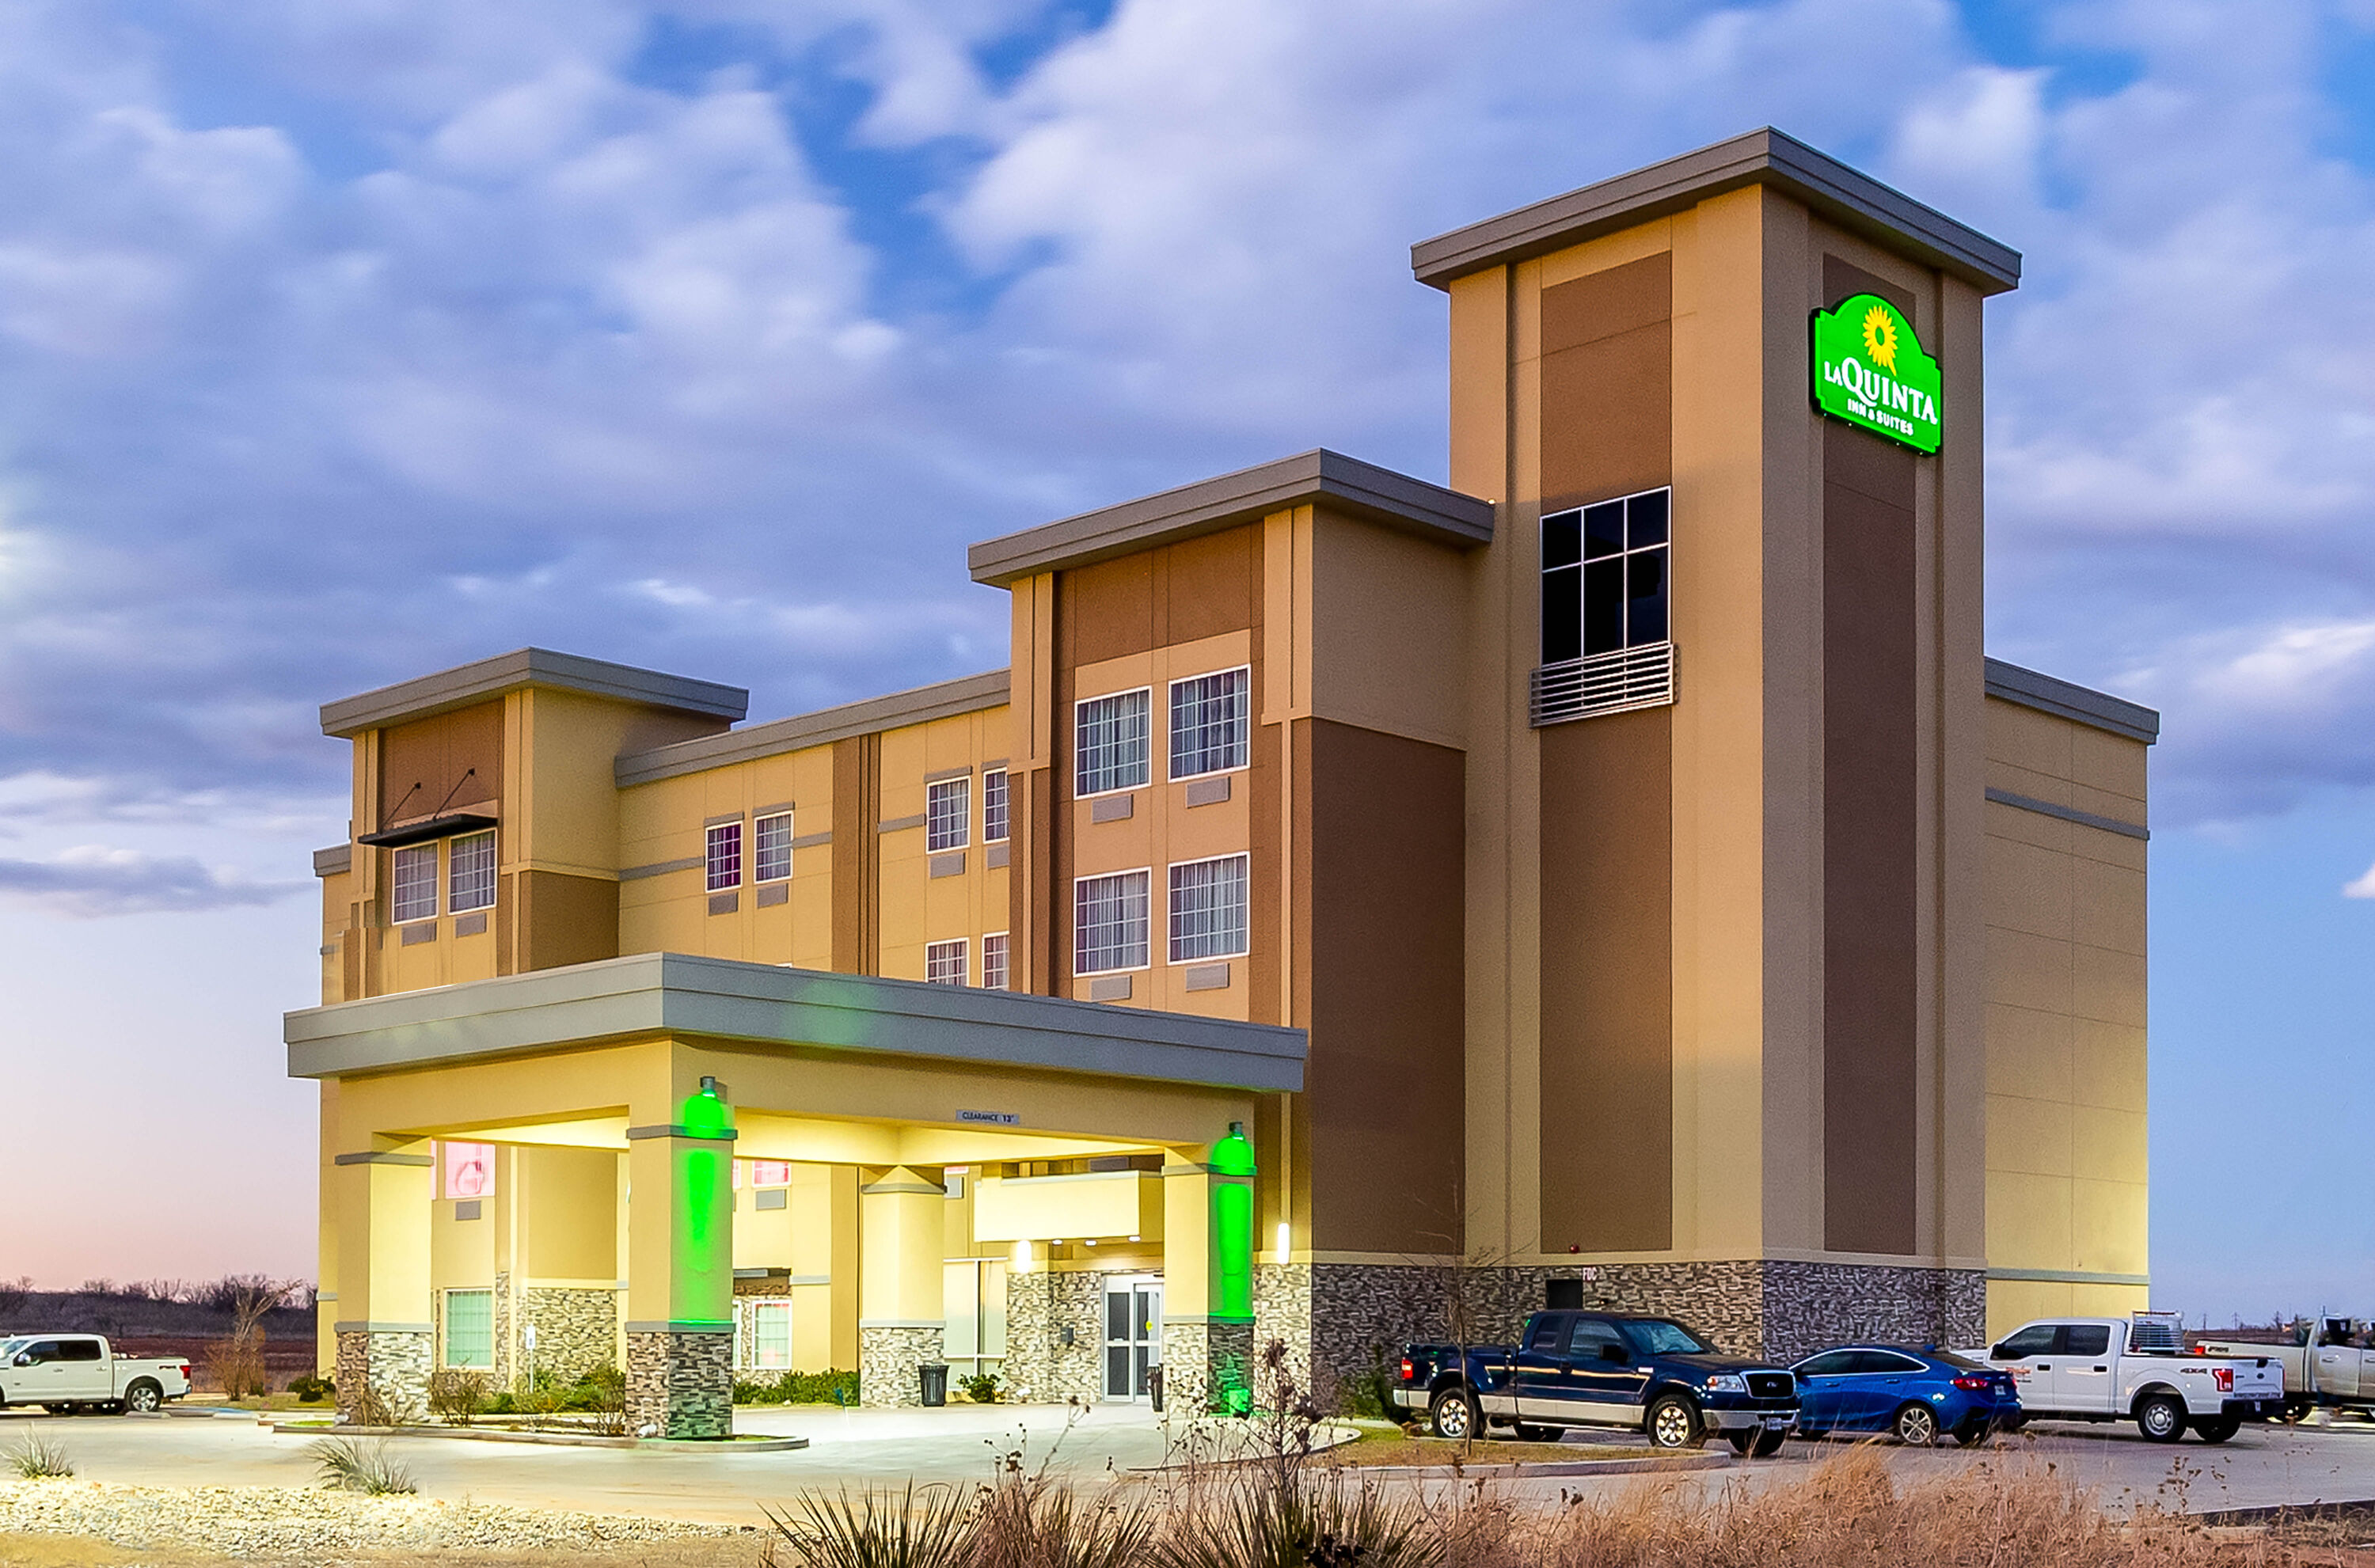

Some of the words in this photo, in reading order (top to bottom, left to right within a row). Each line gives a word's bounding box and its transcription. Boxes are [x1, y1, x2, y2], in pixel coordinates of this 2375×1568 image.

[1824, 361, 1843, 386] LA
[1841, 357, 1938, 425] QUINTA
[1847, 398, 1867, 417] INN
[1868, 408, 1875, 421] &
[1876, 410, 1913, 436] SUITES
[962, 1111, 998, 1122] CLEARANCE
[1583, 1266, 1598, 1281] FDC
